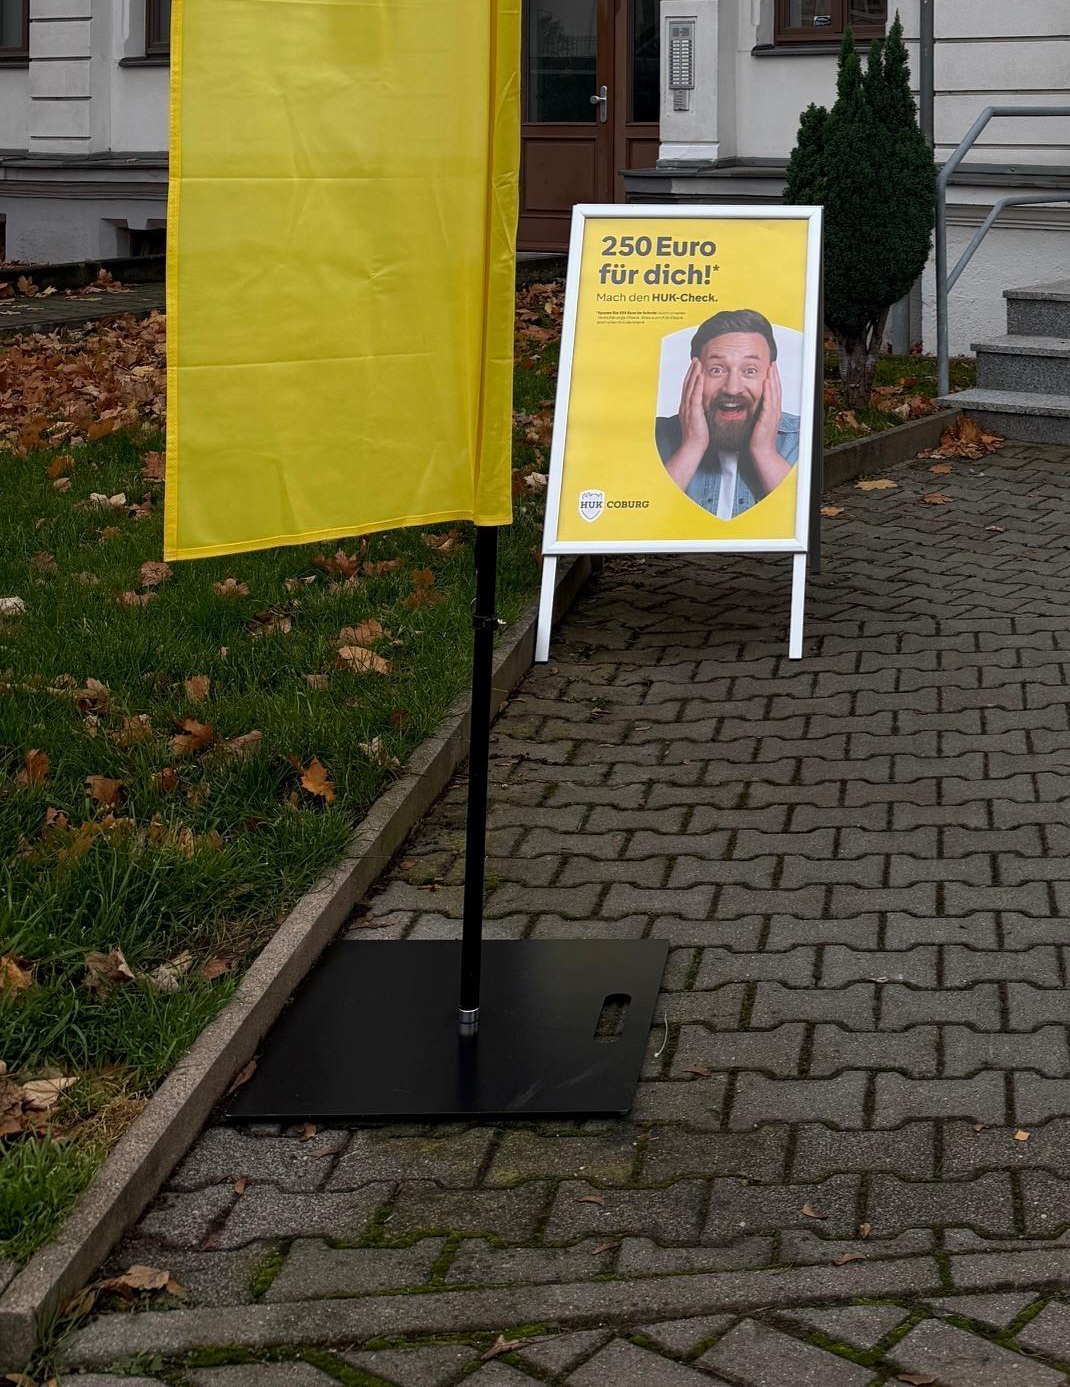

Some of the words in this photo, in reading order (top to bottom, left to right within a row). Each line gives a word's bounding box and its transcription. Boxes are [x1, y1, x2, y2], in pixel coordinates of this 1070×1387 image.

[601, 235, 652, 257] 250
[656, 236, 717, 257] Euro
[598, 263, 639, 285] für
[596, 292, 626, 302] Mach
[628, 292, 650, 302] den
[652, 292, 719, 303] HUK-Check.
[580, 501, 603, 509] HUK
[606, 500, 650, 509] COBURG
